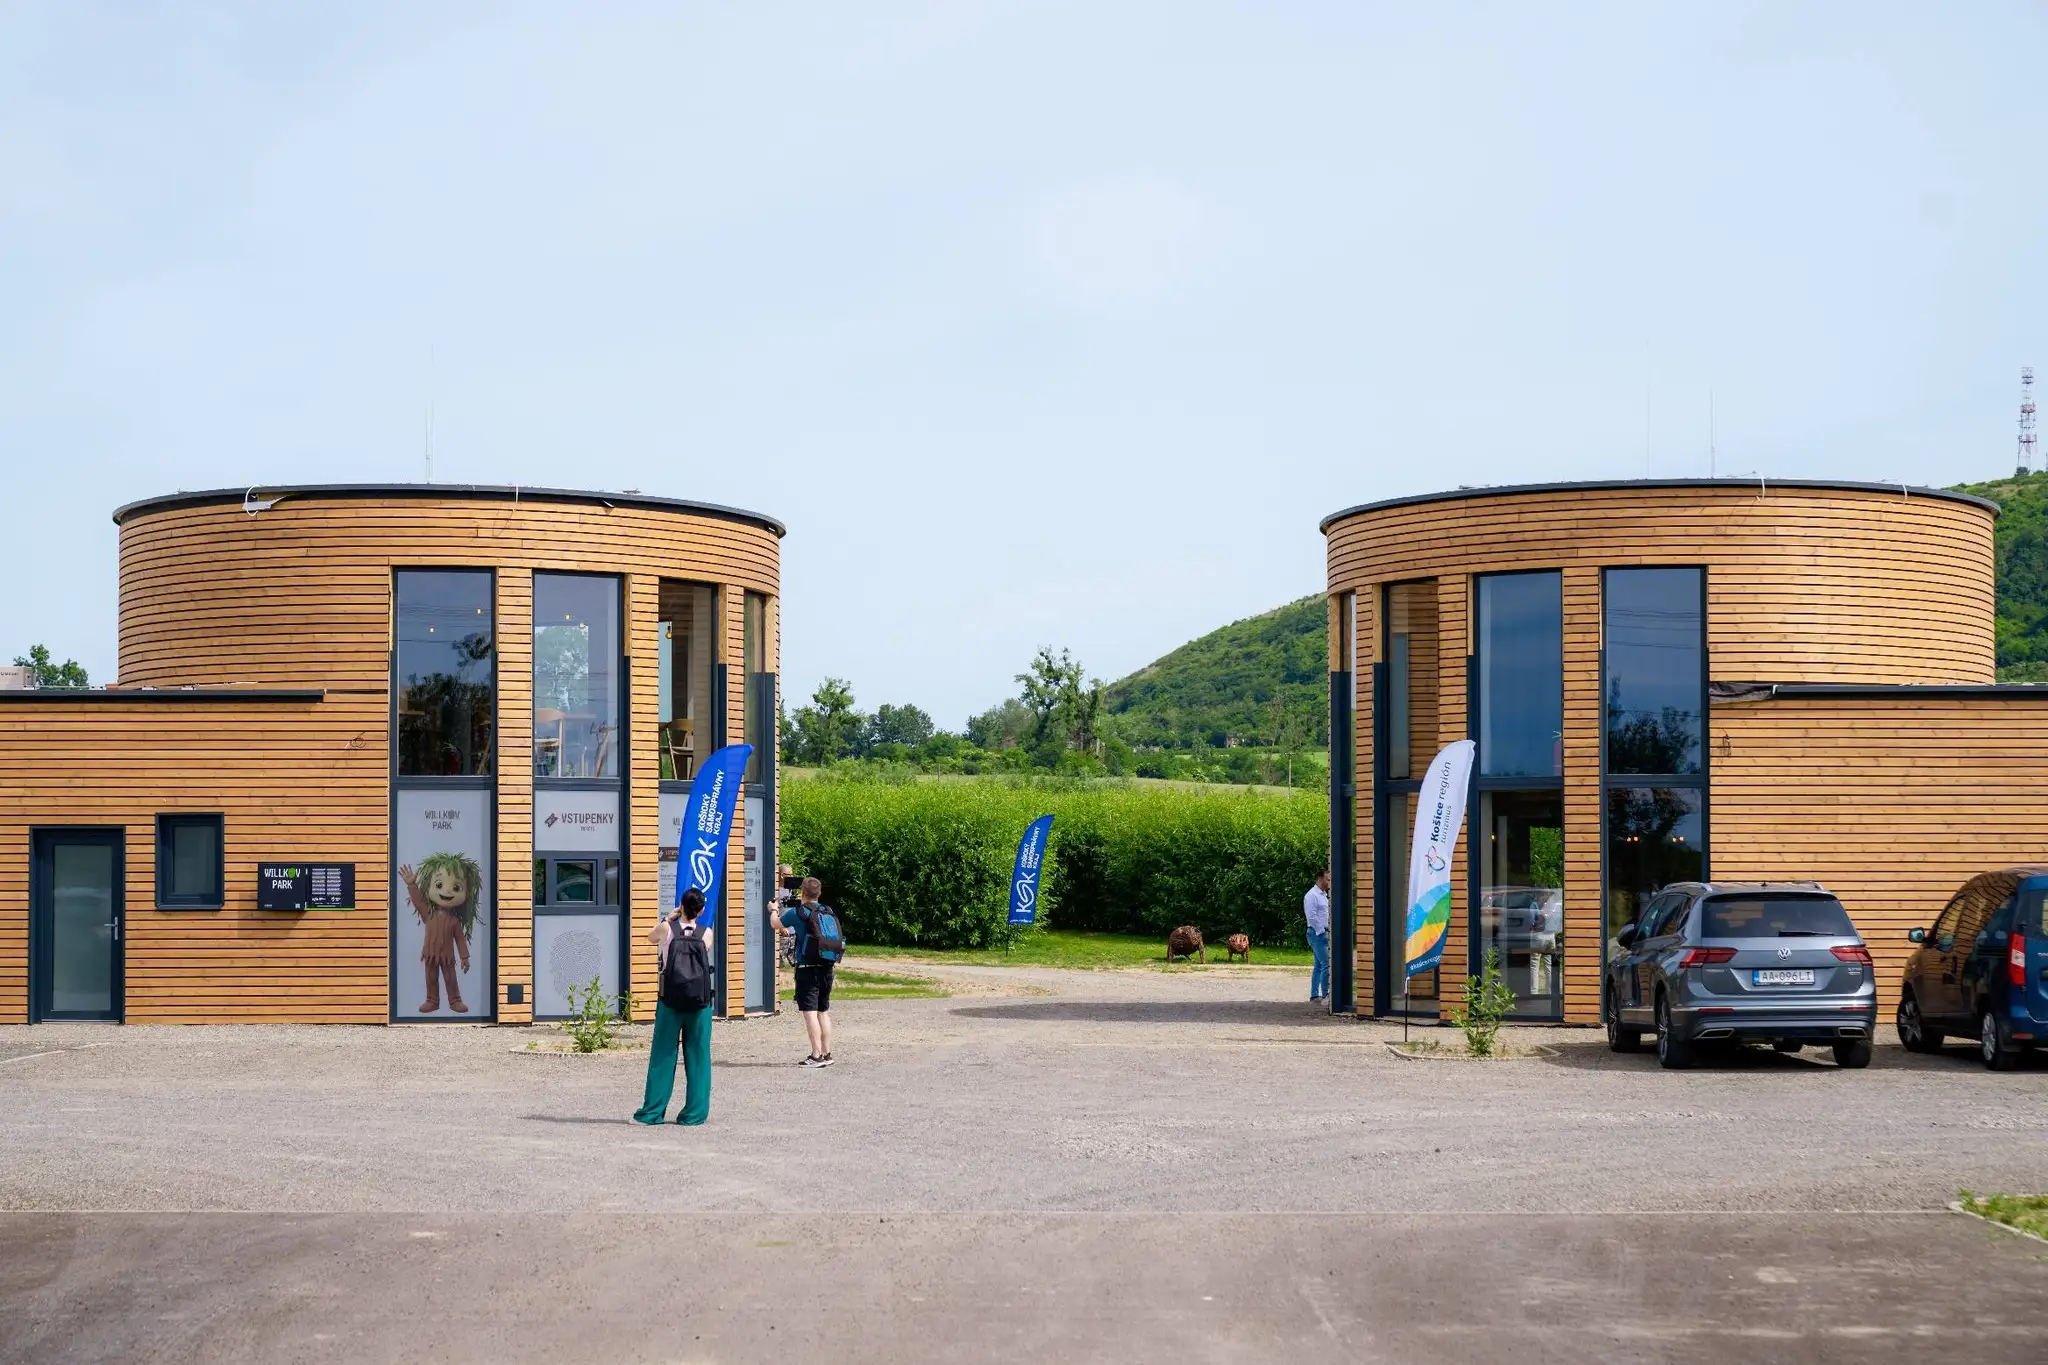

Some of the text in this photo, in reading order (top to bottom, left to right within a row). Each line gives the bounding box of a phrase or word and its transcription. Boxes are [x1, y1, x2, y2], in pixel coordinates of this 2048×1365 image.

[698, 794, 711, 832] KOŠICKÝ
[705, 769, 725, 833] SAMOSPRÁVNY
[1430, 761, 1452, 842] Košice región
[432, 821, 452, 830] PARK
[561, 813, 614, 824] VSTUPENKY
[713, 812, 723, 835] KRAJ
[1441, 805, 1452, 844] turizmus
[272, 880, 293, 889] PARK
